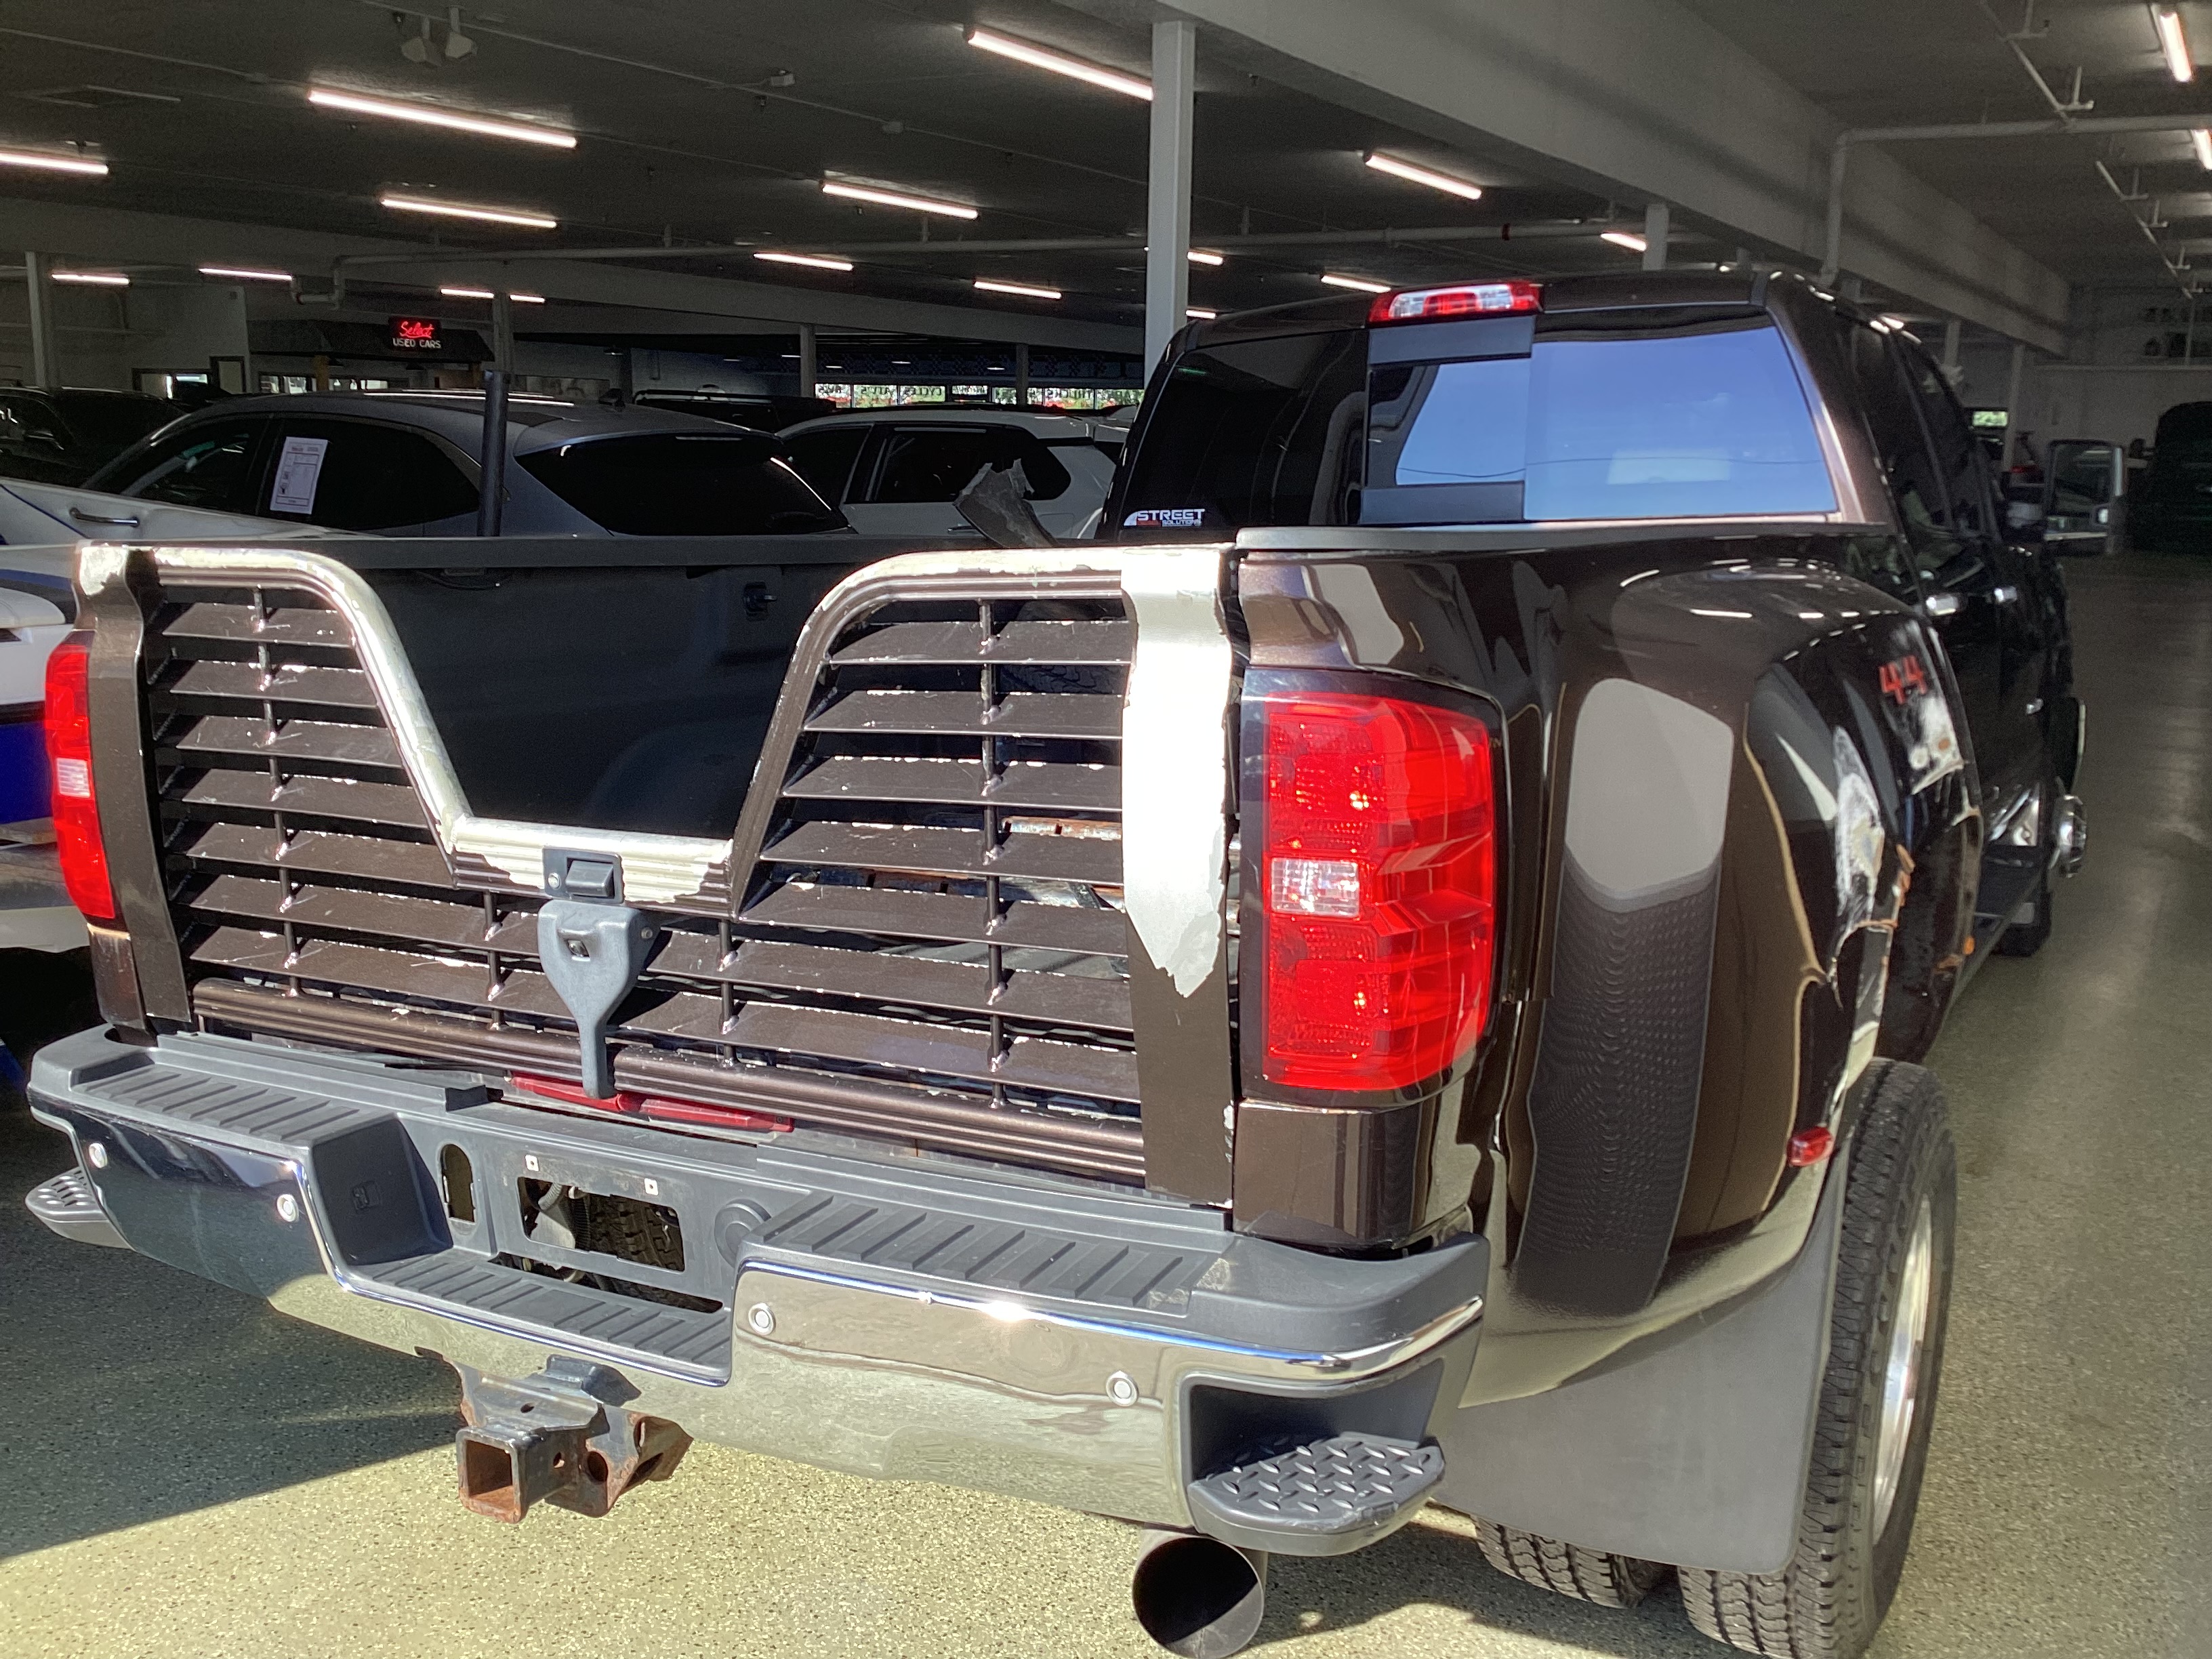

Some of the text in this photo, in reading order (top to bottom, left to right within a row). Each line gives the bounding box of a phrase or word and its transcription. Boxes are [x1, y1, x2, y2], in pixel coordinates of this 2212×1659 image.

[399, 321, 434, 339] Select
[392, 338, 441, 349] USED CARS
[1137, 508, 1206, 521] STREET
